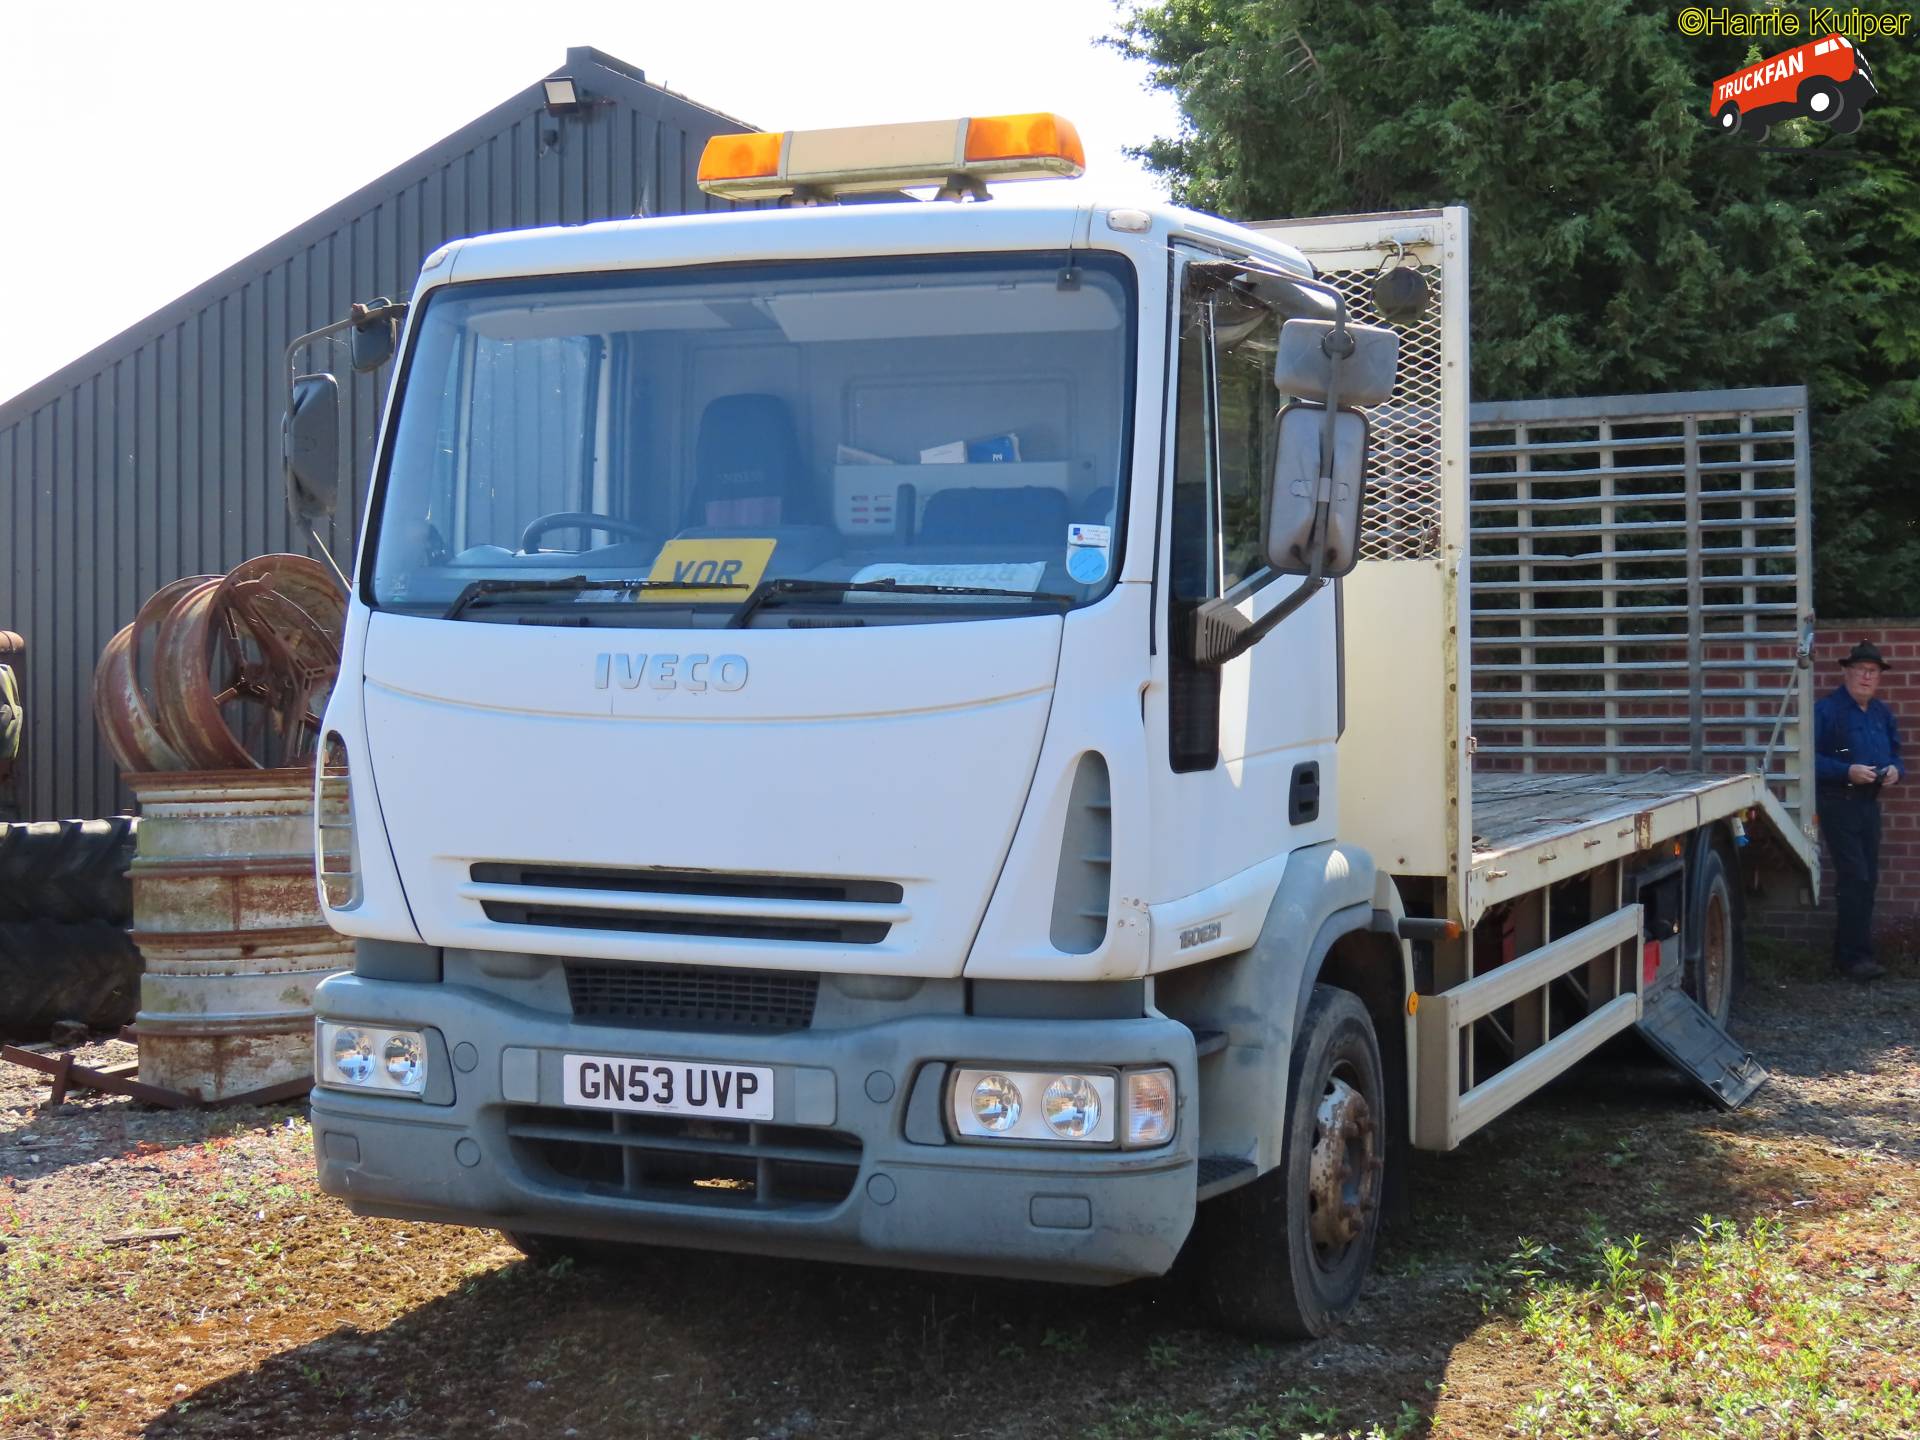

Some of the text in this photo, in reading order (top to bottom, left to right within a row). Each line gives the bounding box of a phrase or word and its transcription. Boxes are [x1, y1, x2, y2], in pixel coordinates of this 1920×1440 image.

[673, 559, 743, 584] VOR
[595, 652, 749, 691] IVECO
[579, 1062, 759, 1109] GN53 UVP
